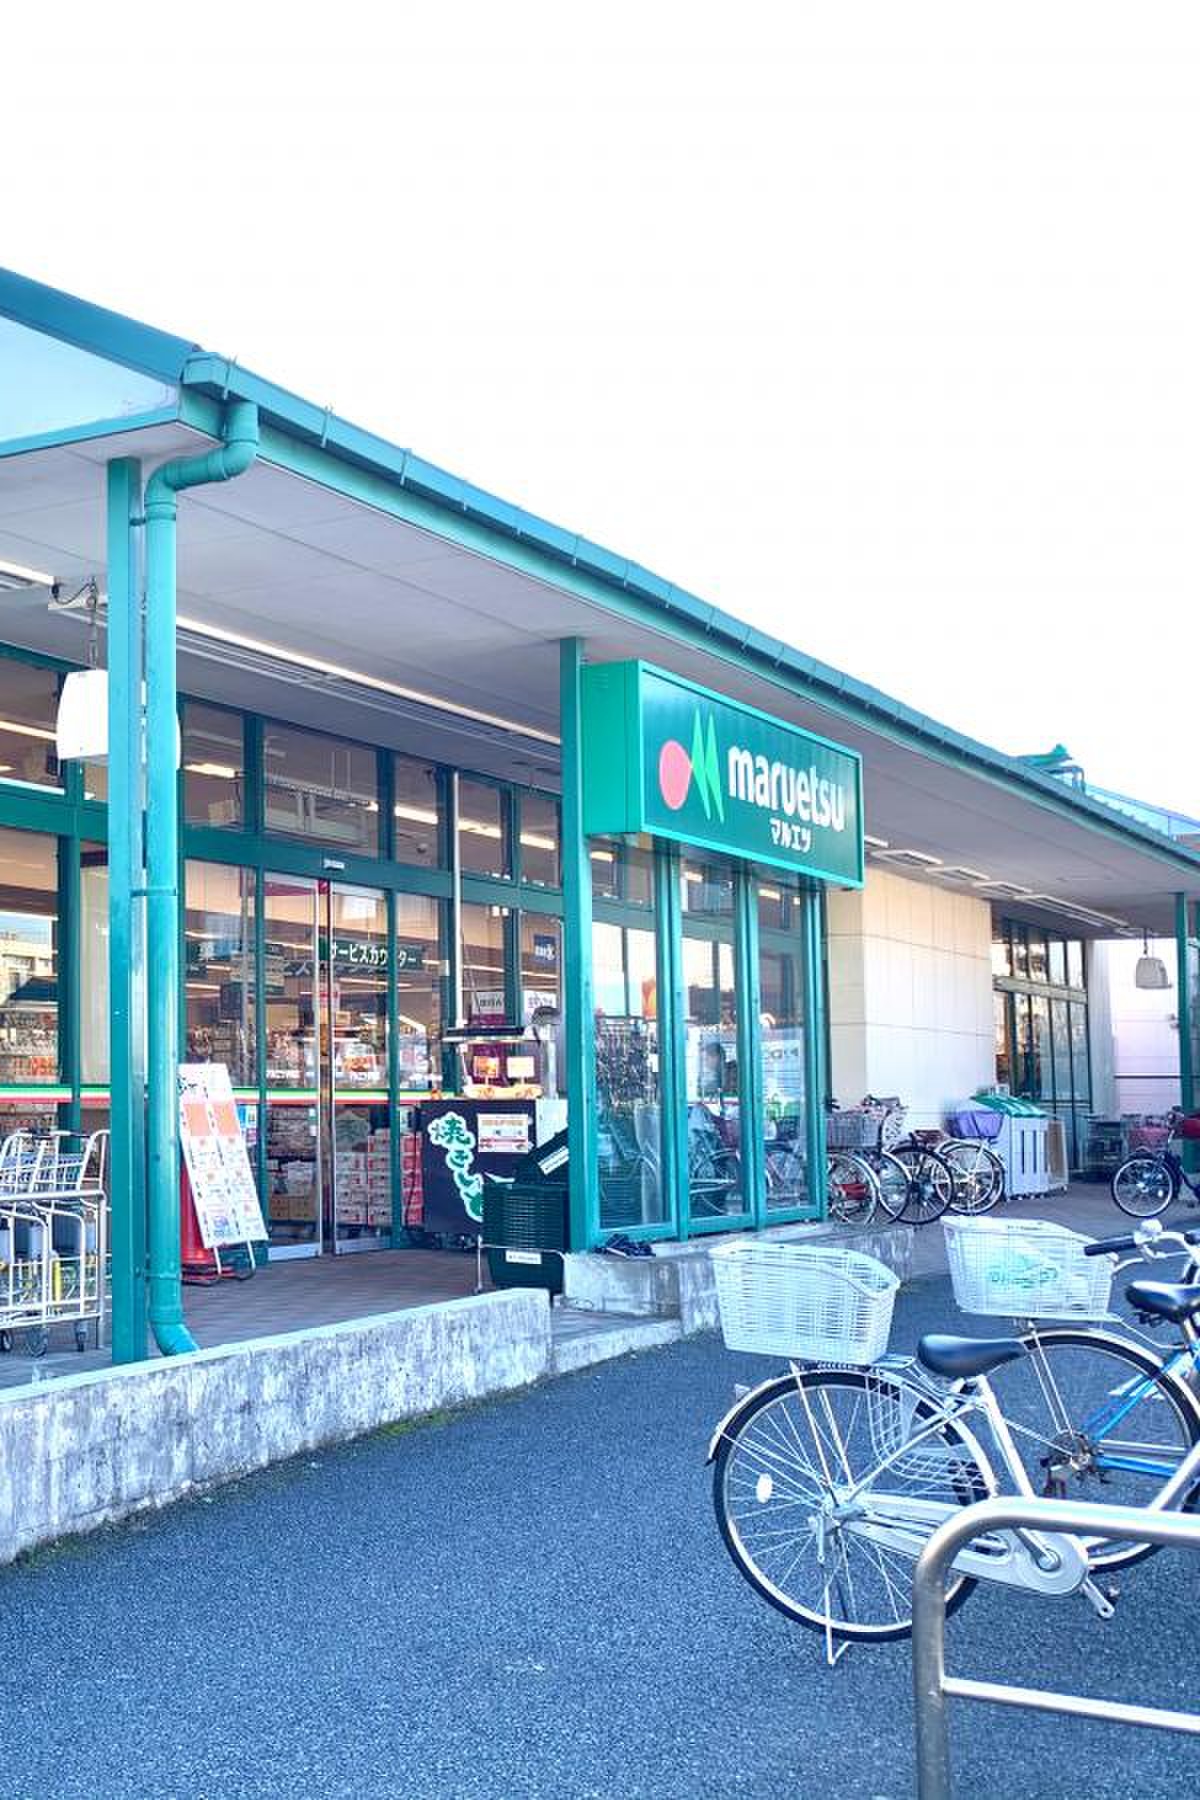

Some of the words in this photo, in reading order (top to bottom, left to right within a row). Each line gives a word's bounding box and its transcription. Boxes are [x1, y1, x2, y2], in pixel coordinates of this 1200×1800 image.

[728, 746, 846, 832] maruetsu
[769, 817, 812, 853] マルエツ
[331, 941, 417, 967] サービスカウター
